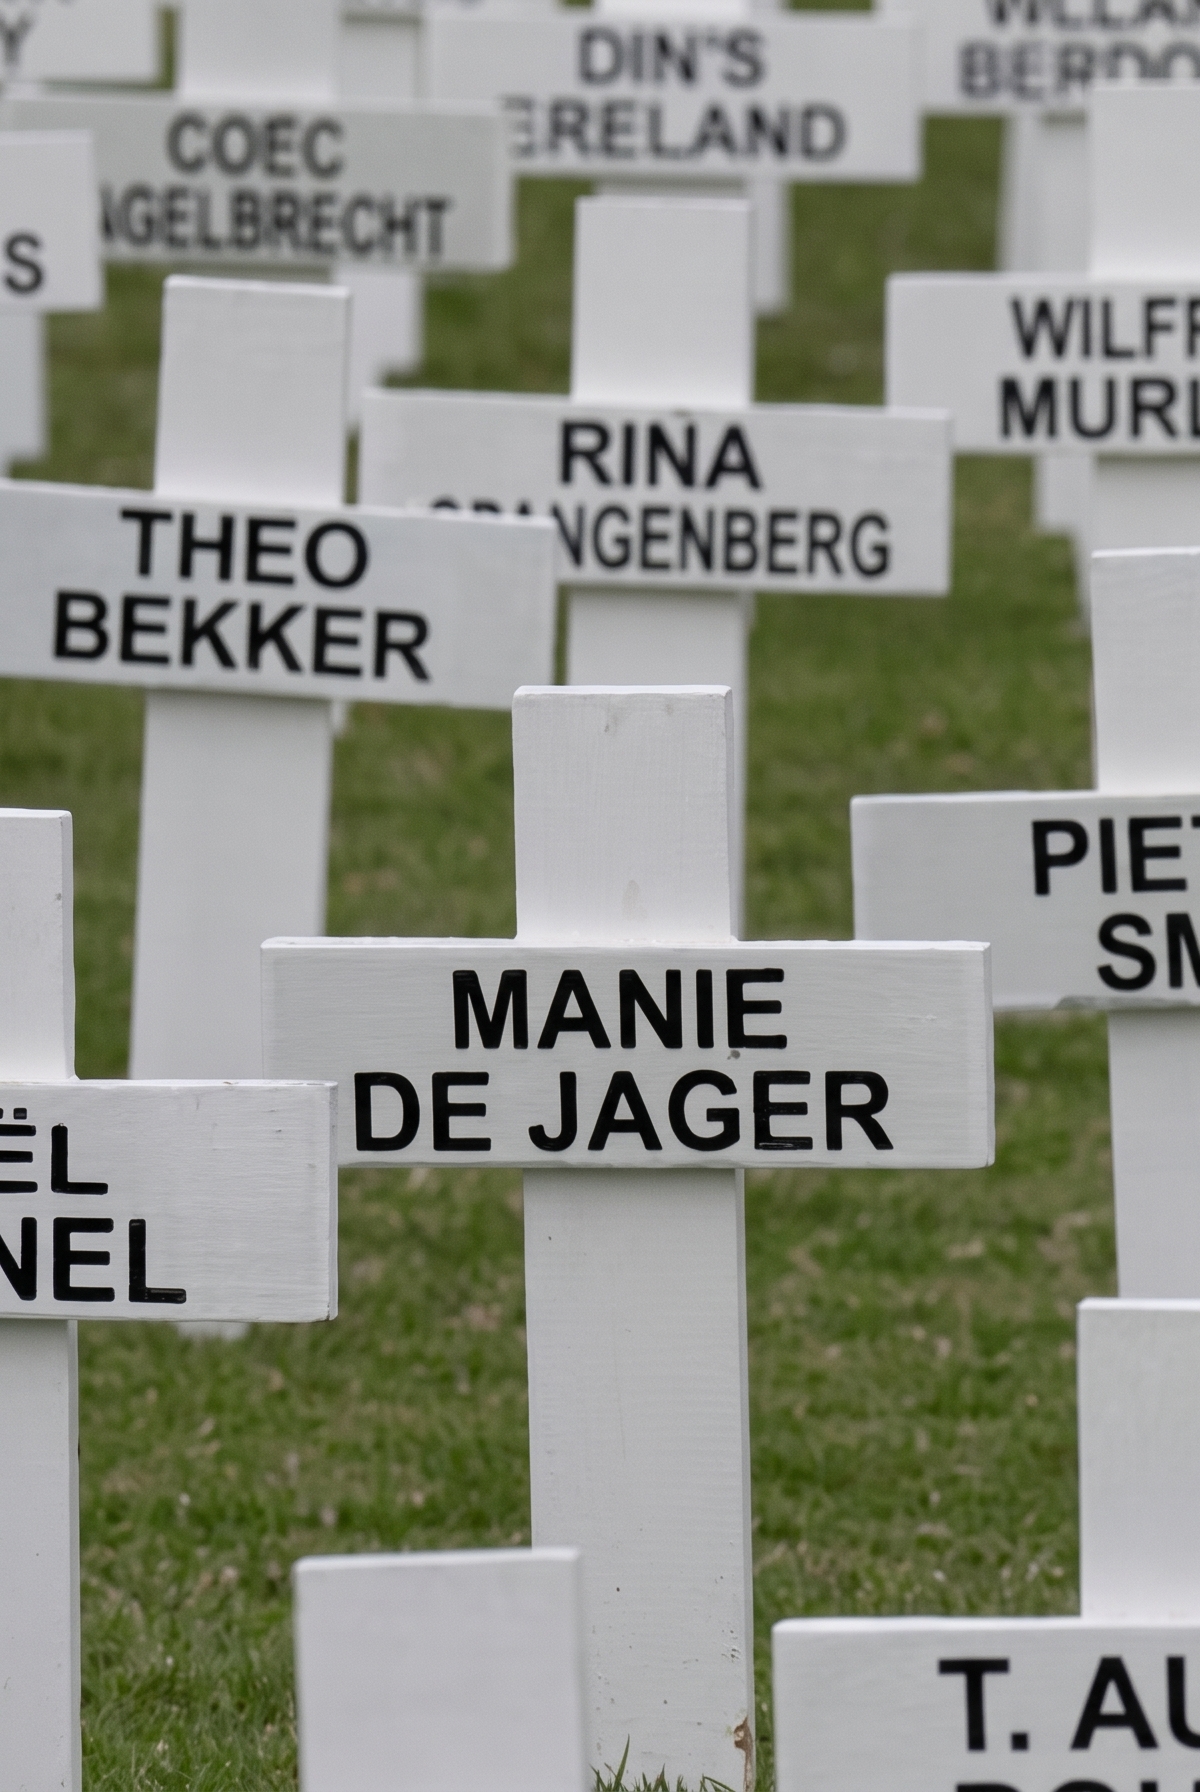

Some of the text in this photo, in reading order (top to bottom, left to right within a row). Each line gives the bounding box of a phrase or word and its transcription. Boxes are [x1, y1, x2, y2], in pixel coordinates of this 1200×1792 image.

[165, 110, 345, 180] COEC
[2, 231, 45, 295] S
[560, 420, 761, 490] RINA
[120, 508, 369, 590] THEO
[433, 498, 890, 579] NGENBERG
[53, 590, 432, 683] BEKKER
[453, 968, 787, 1049] MANIE
[354, 1069, 893, 1152] DE JAGER
[938, 1658, 1029, 1752] T.
